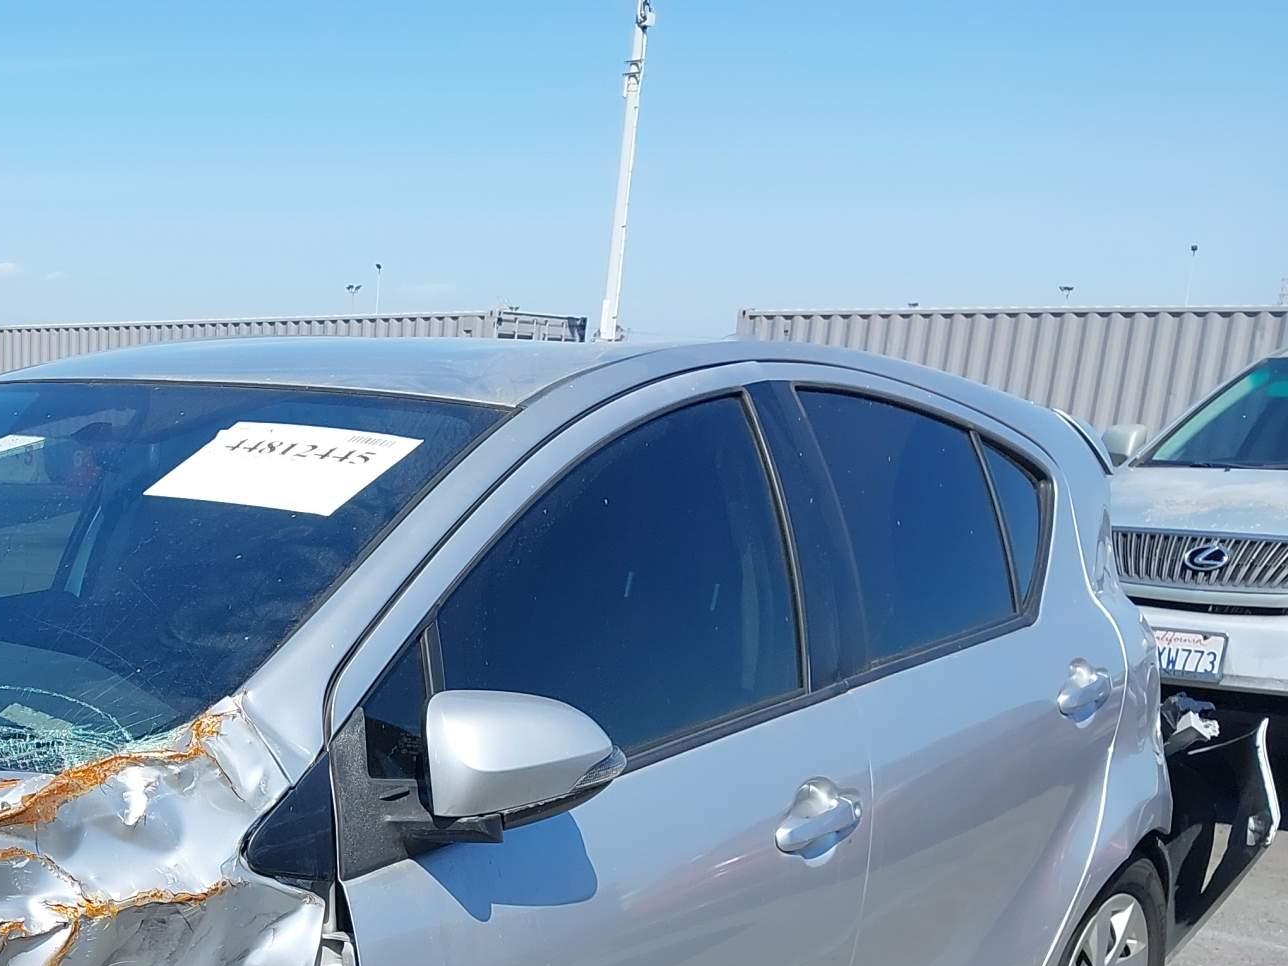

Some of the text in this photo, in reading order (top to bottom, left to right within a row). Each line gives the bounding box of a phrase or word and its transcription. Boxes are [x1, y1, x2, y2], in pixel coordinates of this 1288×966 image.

[225, 439, 377, 466] 44812445
[1155, 631, 1202, 645] alifornia
[1157, 646, 1217, 674] XW773
